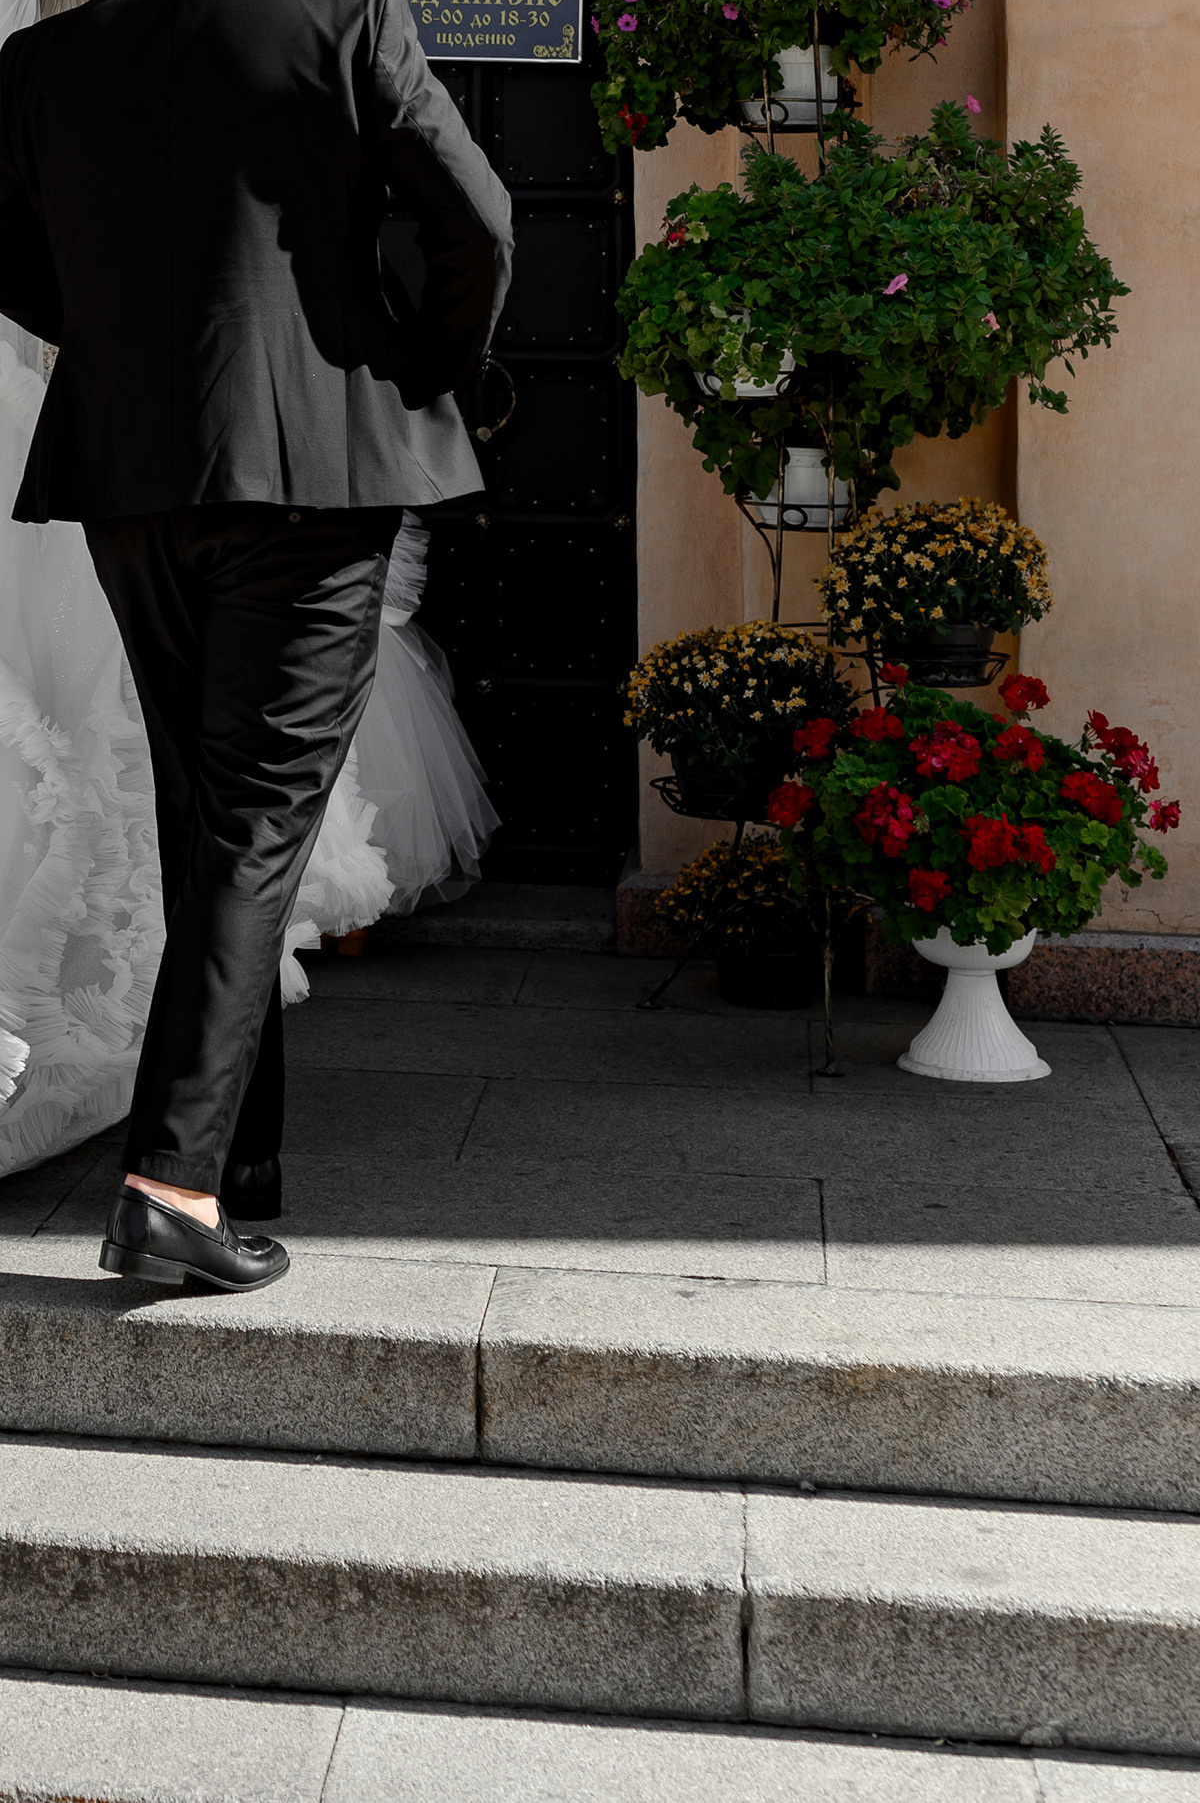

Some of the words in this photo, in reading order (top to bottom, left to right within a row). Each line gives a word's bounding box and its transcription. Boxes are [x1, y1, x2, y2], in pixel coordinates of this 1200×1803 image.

[422, 9, 463, 24] 8-00
[470, 14, 490, 28] до
[501, 10, 549, 27] 18-30
